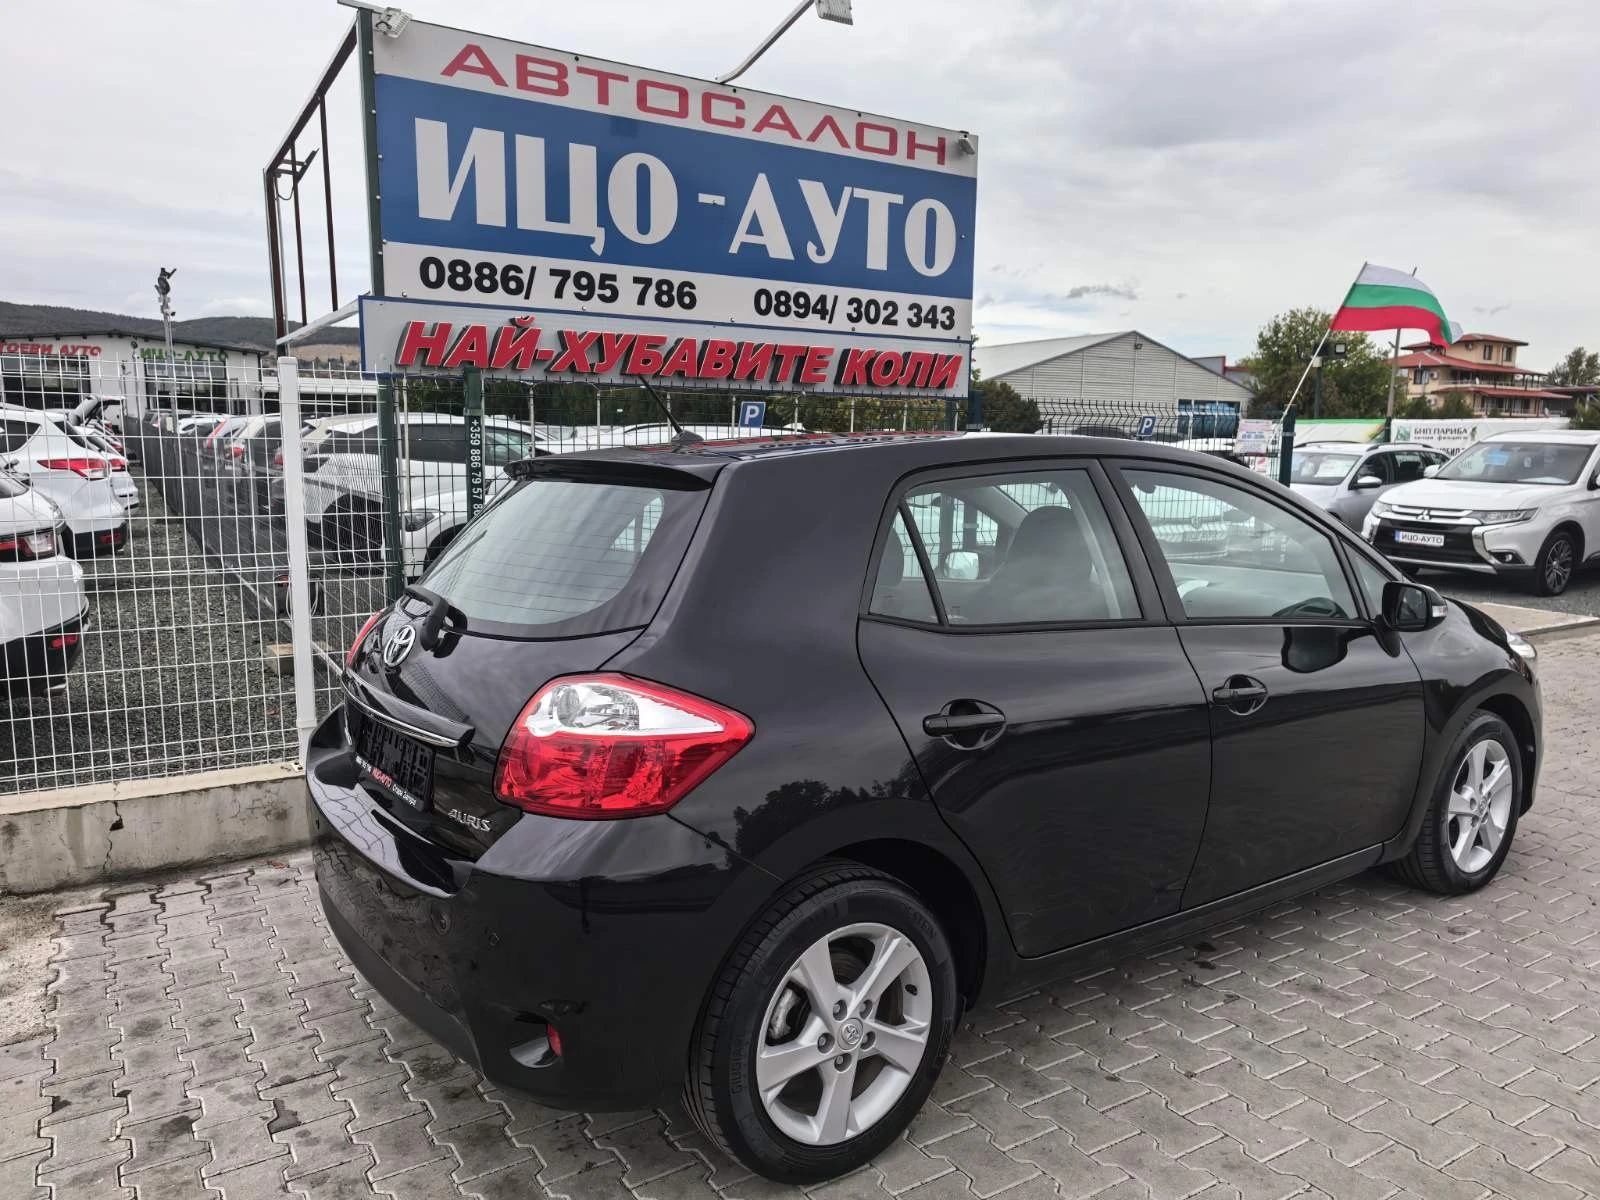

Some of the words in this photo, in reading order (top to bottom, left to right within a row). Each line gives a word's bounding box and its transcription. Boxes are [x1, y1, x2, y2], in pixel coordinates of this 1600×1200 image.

[441, 44, 946, 166] АВТОСАЛОН
[415, 117, 679, 256] ИЦО
[728, 173, 957, 278] АУТО
[419, 256, 538, 300] 0886/
[549, 268, 620, 305] 795
[632, 276, 698, 311] 786
[753, 288, 839, 324] 0894/
[846, 297, 899, 326] 302
[906, 303, 956, 331] 343
[60, 344, 102, 356] АУТО
[397, 316, 833, 386] НАЙ-ХУБАВИТЕ
[841, 348, 963, 389] КОЛИ
[744, 404, 760, 425] P
[470, 419, 481, 446] +359
[1141, 418, 1153, 434] P
[1433, 427, 1468, 435] ПАРИБА
[470, 448, 481, 468] 886
[471, 471, 482, 484] 79
[472, 487, 482, 500] 57
